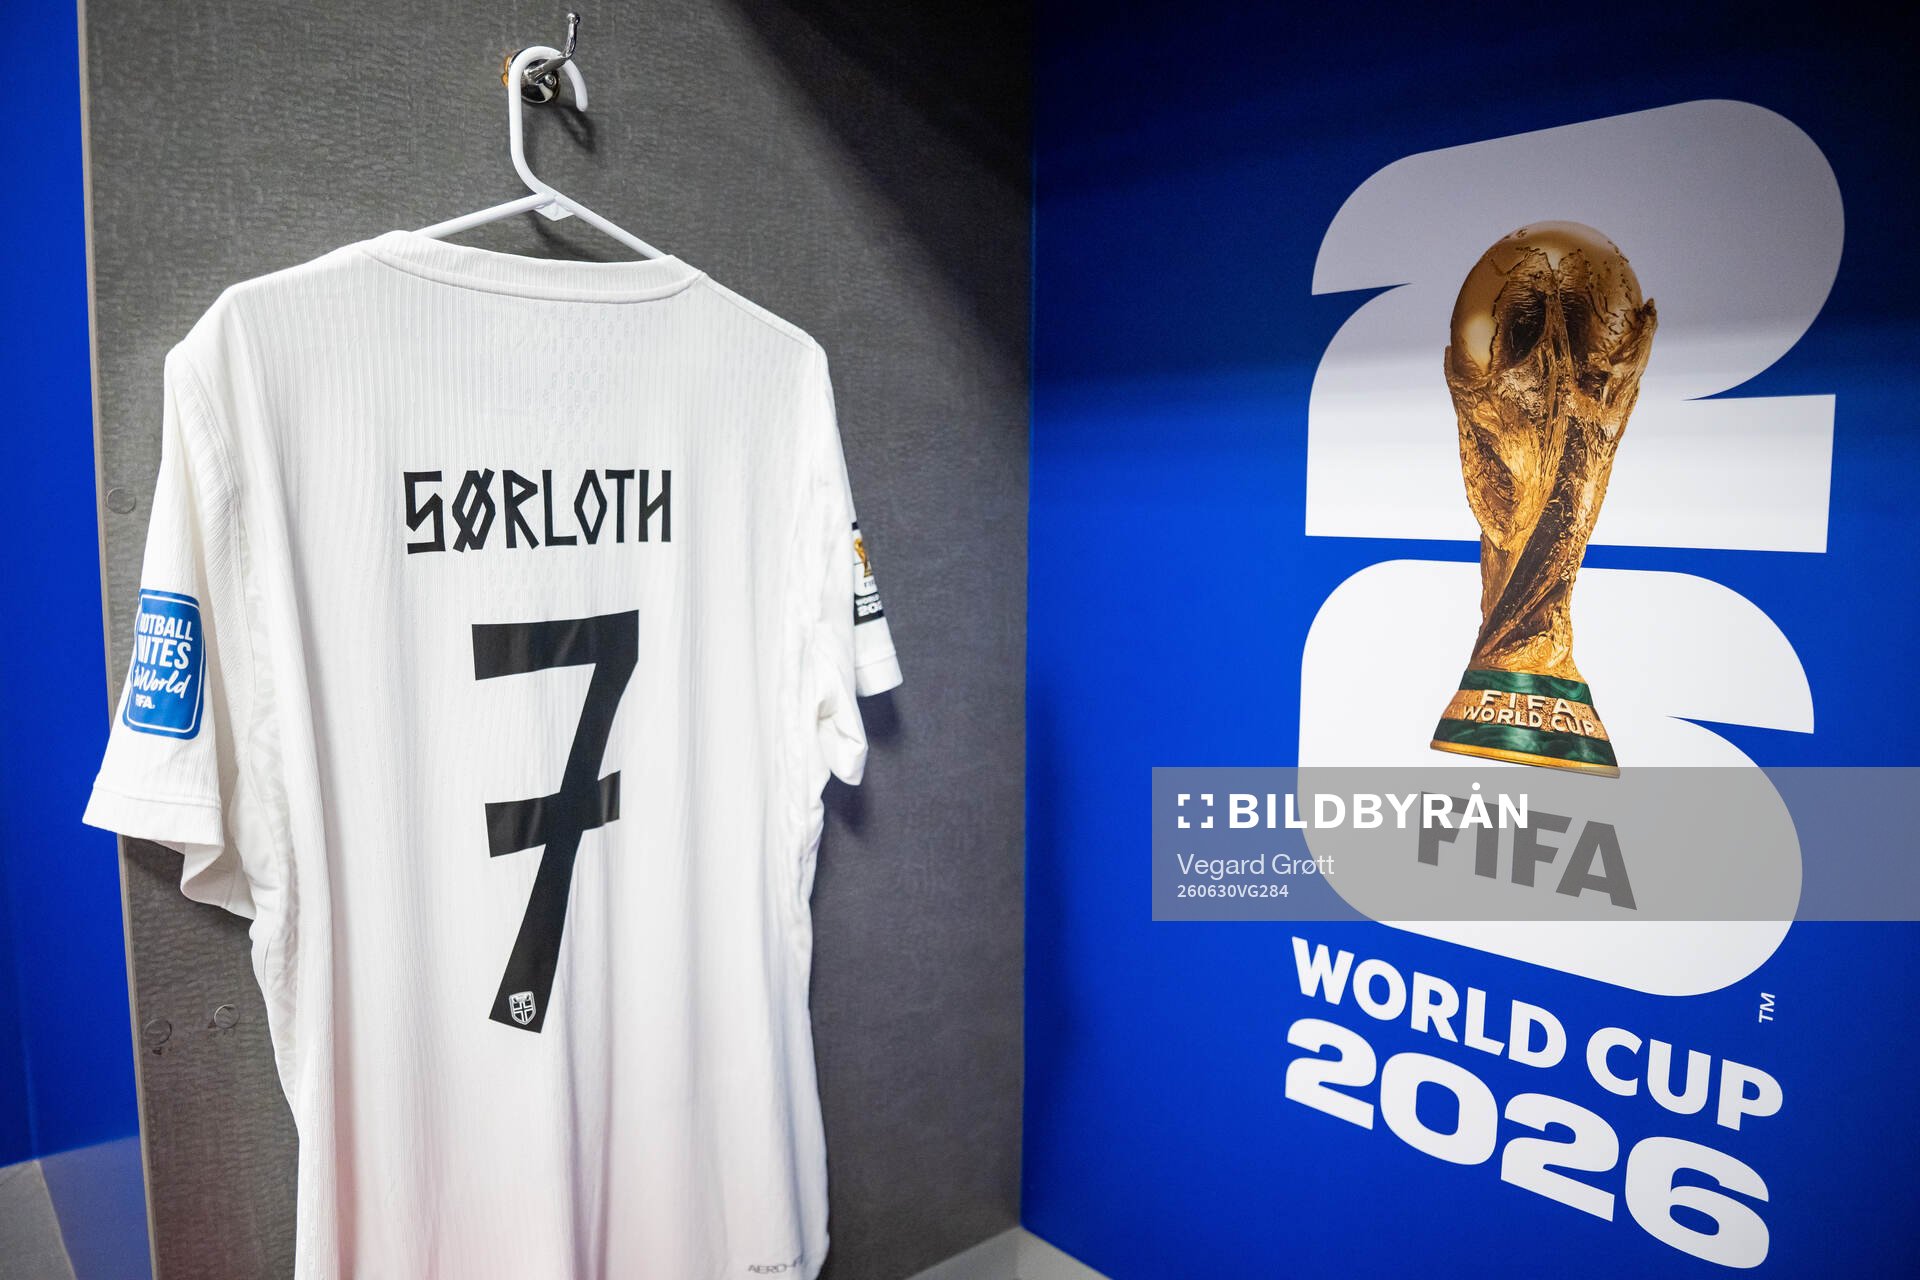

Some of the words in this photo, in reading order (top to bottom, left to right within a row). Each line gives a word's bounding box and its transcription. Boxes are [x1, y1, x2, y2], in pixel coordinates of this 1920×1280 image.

[404, 468, 671, 554] SØRLOTH
[1463, 706, 1542, 728] WORLD
[1550, 715, 1595, 736] CUP
[1480, 689, 1577, 717] FIFA
[471, 609, 639, 1034] 7
[1418, 791, 1637, 910] FIFA
[1292, 936, 1567, 1068] WORLD
[1586, 1027, 1784, 1131] CUP
[1758, 992, 1775, 1024] TM
[1285, 1018, 1770, 1270] 2026
